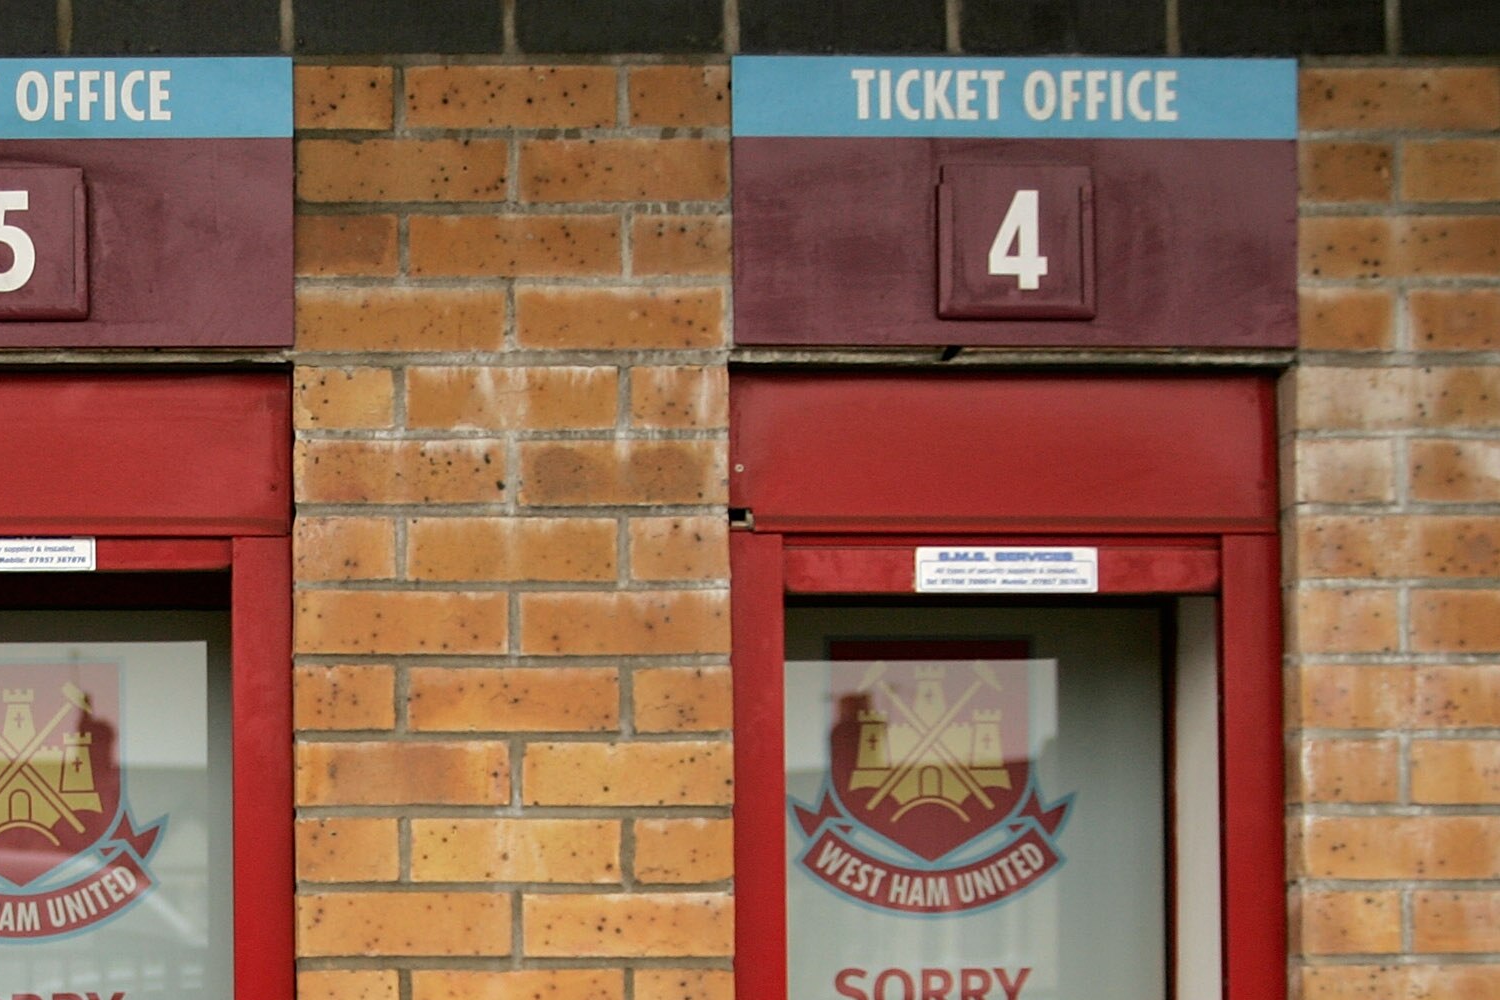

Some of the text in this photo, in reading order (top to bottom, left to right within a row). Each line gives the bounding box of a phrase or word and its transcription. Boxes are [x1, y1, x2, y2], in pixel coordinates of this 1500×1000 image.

[15, 70, 172, 121] OFFICE
[851, 69, 1179, 122] TICKET OFFICE
[987, 189, 1048, 290] 4
[4, 545, 34, 554] supplied
[994, 552, 1074, 561] SERVICES
[48, 864, 138, 930] UNITED
[815, 840, 1046, 907] WEST HAM UNITED
